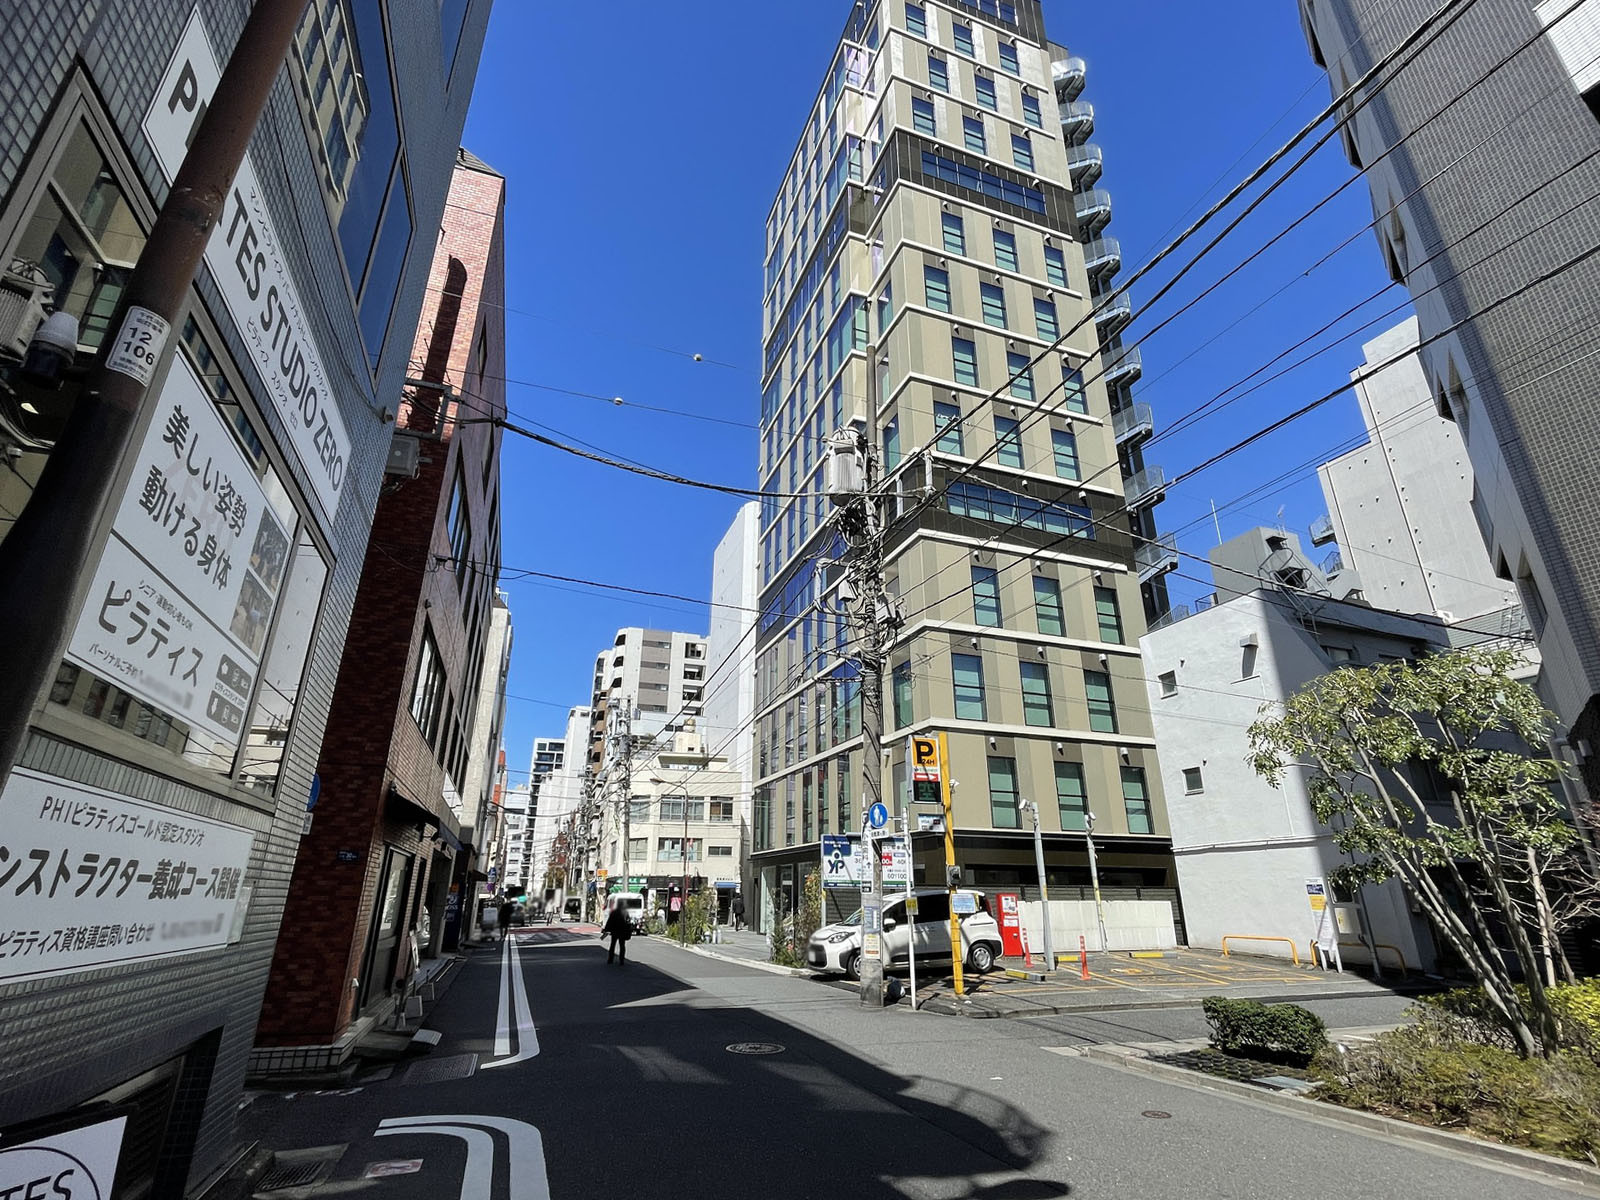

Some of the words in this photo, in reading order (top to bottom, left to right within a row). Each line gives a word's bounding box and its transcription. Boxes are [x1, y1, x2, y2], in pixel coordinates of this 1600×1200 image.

[123, 341, 155, 365] 106
[129, 327, 153, 346] 12
[260, 285, 318, 429] STUDIO
[312, 409, 343, 491] ZERO
[162, 405, 247, 538] 美しい姿勢
[138, 464, 232, 591] 動ける身体
[98, 580, 204, 688] ピラティス
[916, 741, 934, 764] P
[39, 796, 205, 847] PHIピラティスゴールド認定スタジオ
[0, 923, 154, 959] ピラティス資格講座問い合わせ
